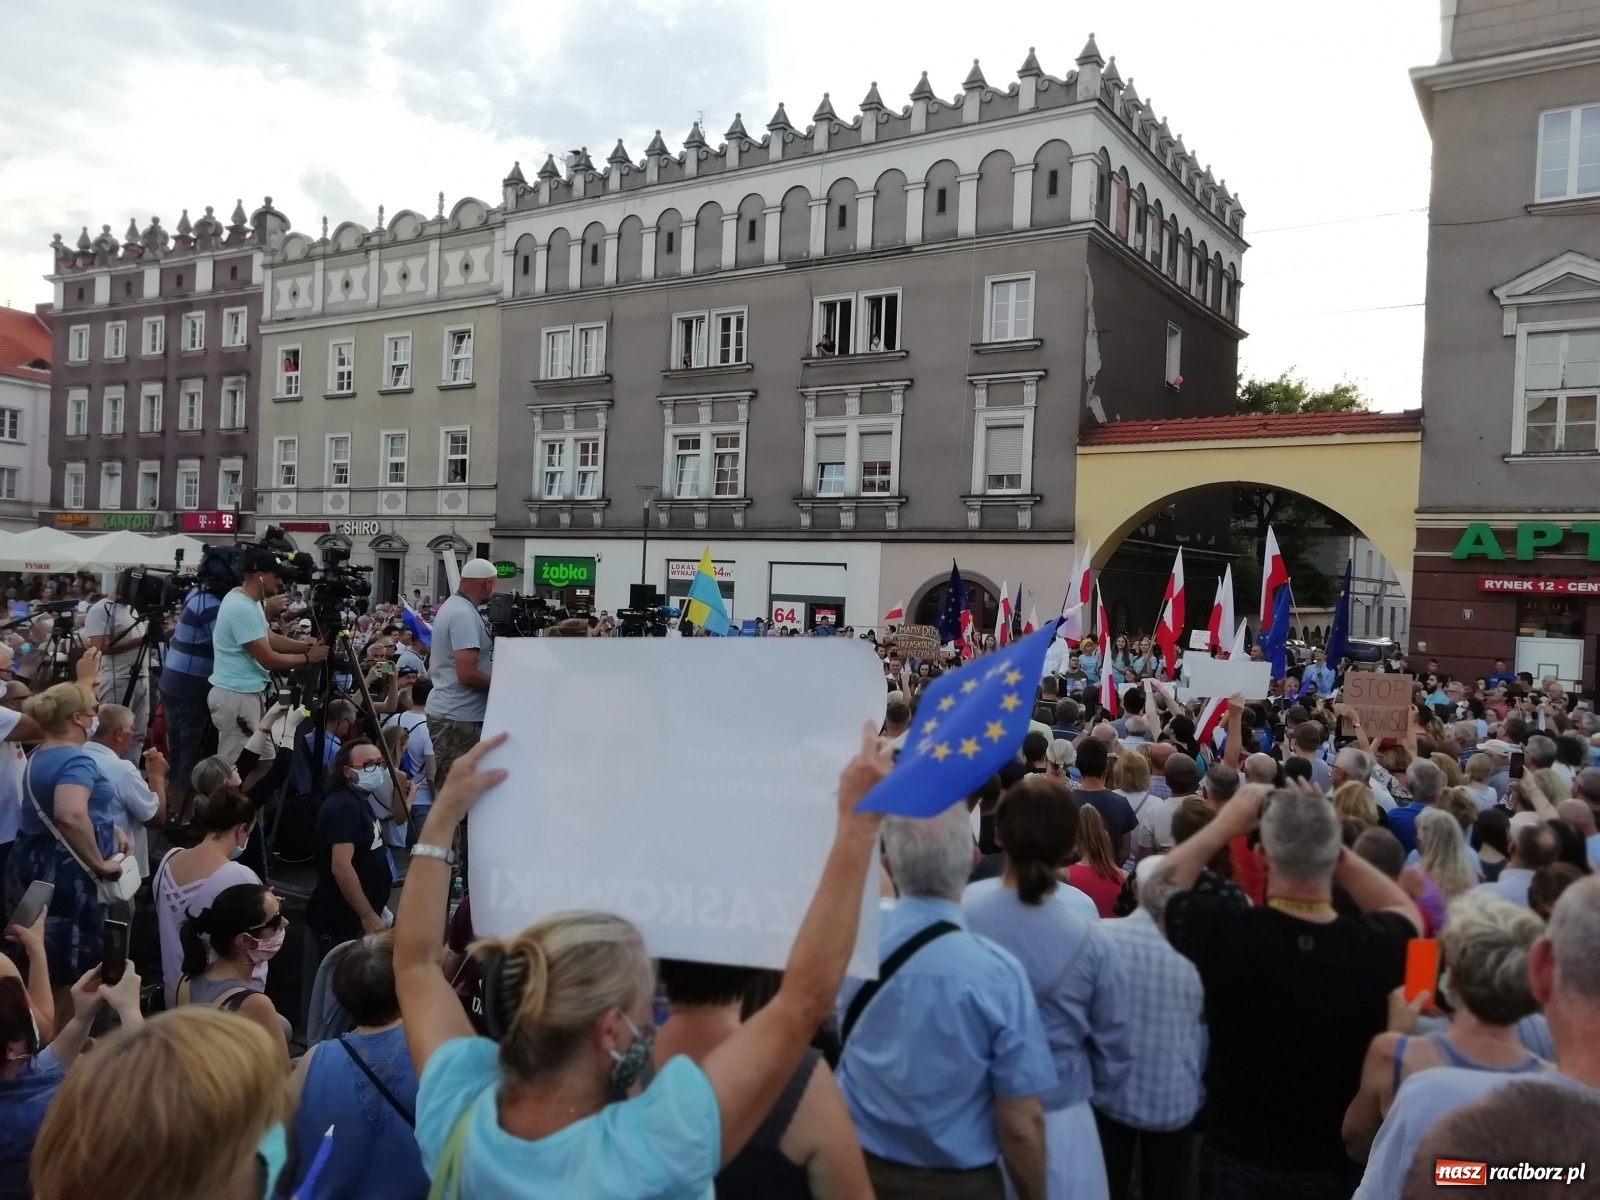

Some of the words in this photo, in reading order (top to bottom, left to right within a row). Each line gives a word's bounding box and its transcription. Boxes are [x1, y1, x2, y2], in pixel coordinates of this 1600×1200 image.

[102, 513, 151, 529] KANTOR
[344, 521, 379, 535] SHIRO
[24, 562, 51, 570] TYSKIE
[542, 562, 588, 580] żabka
[1484, 580, 1534, 590] RYNEK
[1537, 581, 1555, 591] 12
[1567, 582, 1600, 592] CEN
[899, 625, 921, 634] MAMY
[1349, 678, 1407, 699] STOP
